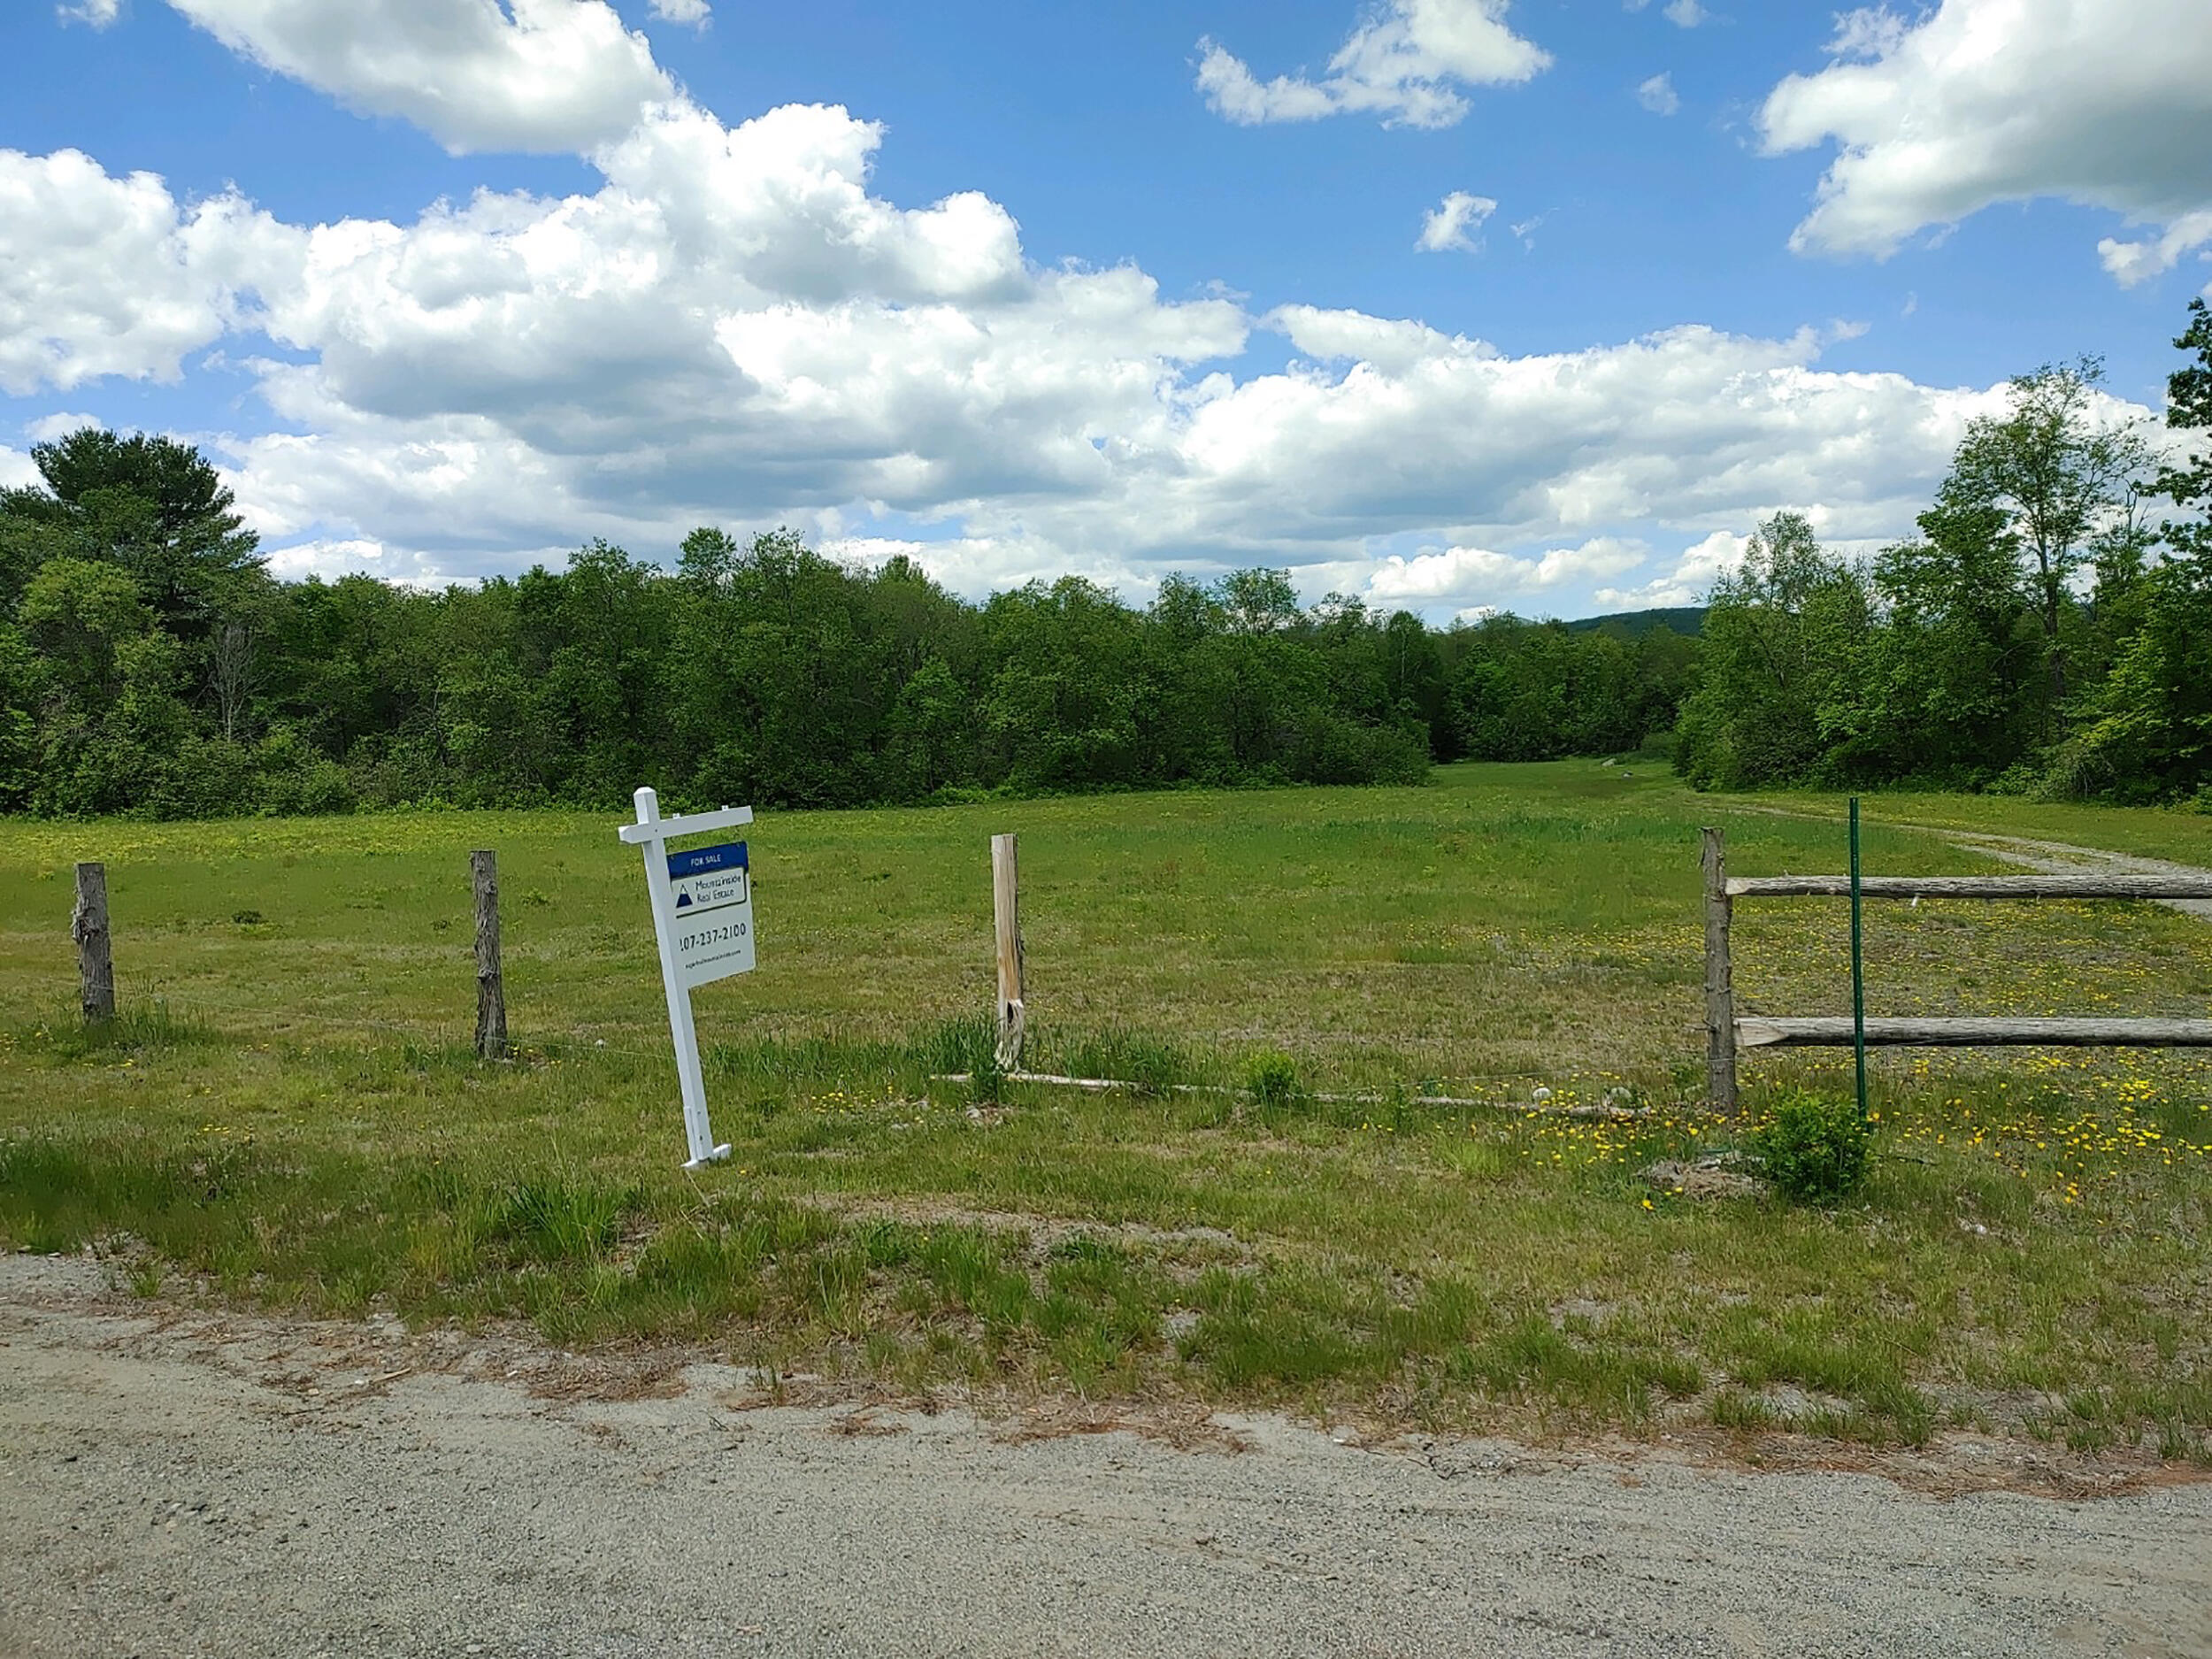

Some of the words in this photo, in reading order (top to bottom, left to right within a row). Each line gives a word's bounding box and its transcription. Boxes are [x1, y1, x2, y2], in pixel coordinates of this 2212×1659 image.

[690, 856, 704, 867] FOR
[705, 854, 721, 864] SALE
[695, 875, 741, 891] Mountainside
[697, 892, 711, 902] Real
[713, 888, 734, 900] Estate
